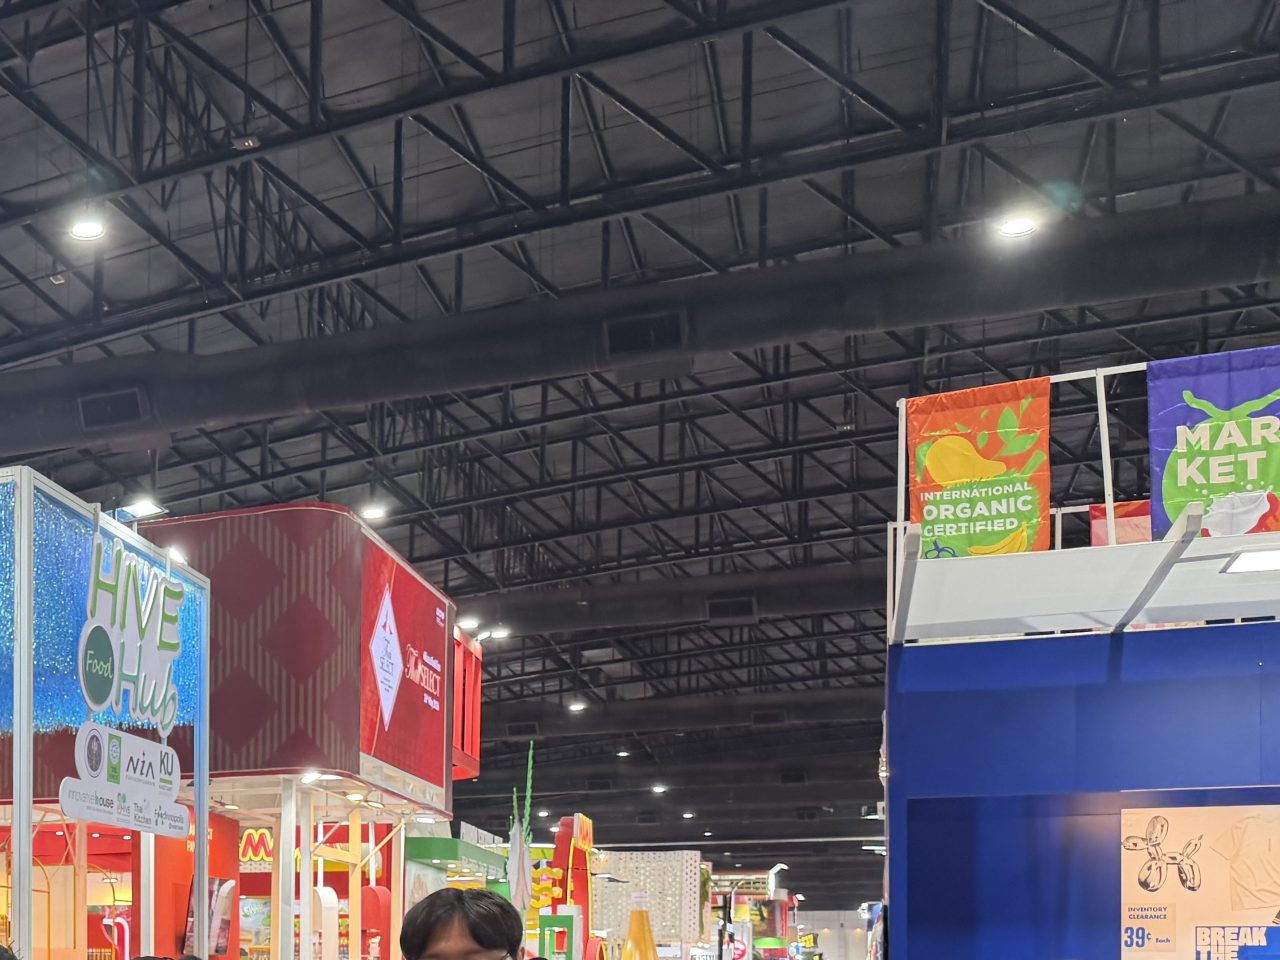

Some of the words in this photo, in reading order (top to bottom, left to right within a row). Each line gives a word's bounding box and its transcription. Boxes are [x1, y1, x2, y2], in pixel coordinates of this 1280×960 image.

[1176, 415, 1280, 453] MAR
[1177, 450, 1267, 487] KET
[920, 481, 1032, 501] INTERNATIONAL
[923, 495, 1033, 520] ORGANIC
[923, 517, 1018, 537] CERTIFIED
[85, 650, 113, 679] Food
[115, 640, 178, 731] Hub
[421, 663, 441, 697] SELECT
[159, 750, 174, 777] KU
[1196, 926, 1268, 946] BREAK
